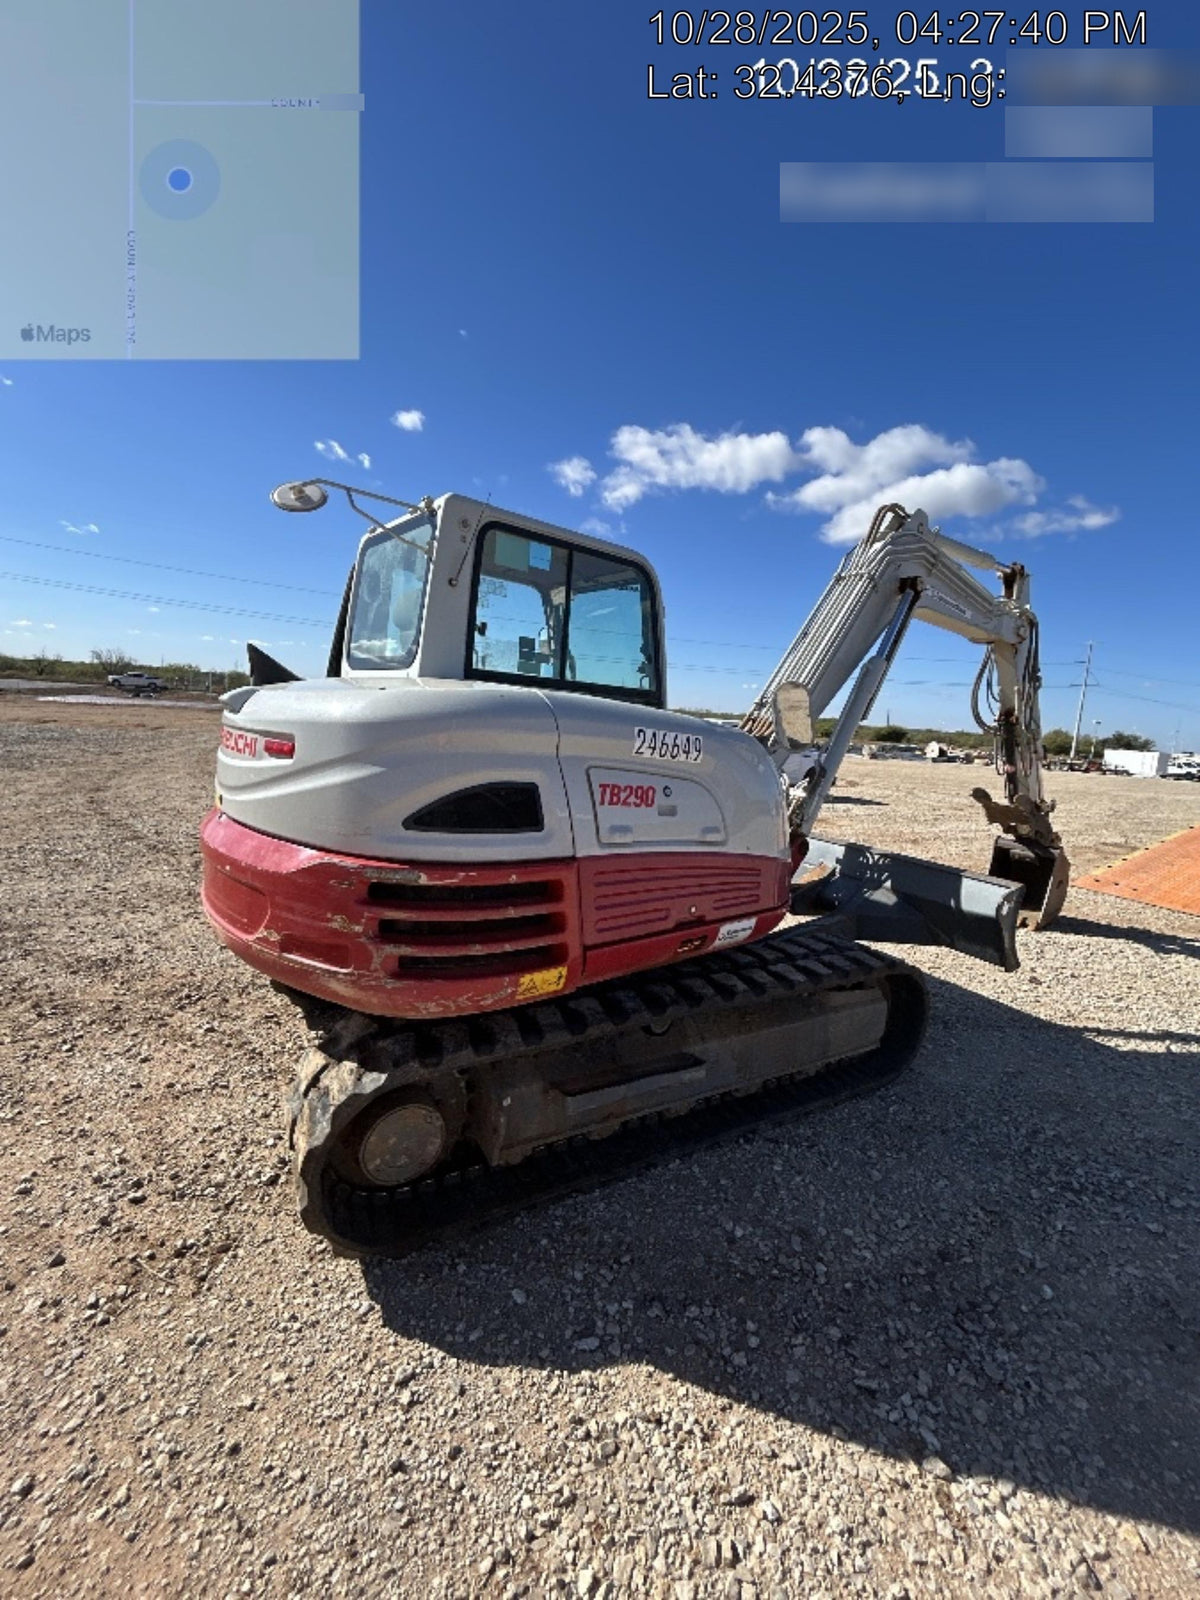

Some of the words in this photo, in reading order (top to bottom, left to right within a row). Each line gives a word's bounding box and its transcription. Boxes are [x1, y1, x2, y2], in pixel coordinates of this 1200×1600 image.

[220, 725, 259, 758] EUCHI
[634, 727, 703, 762] 246649
[598, 782, 657, 809] TB290
